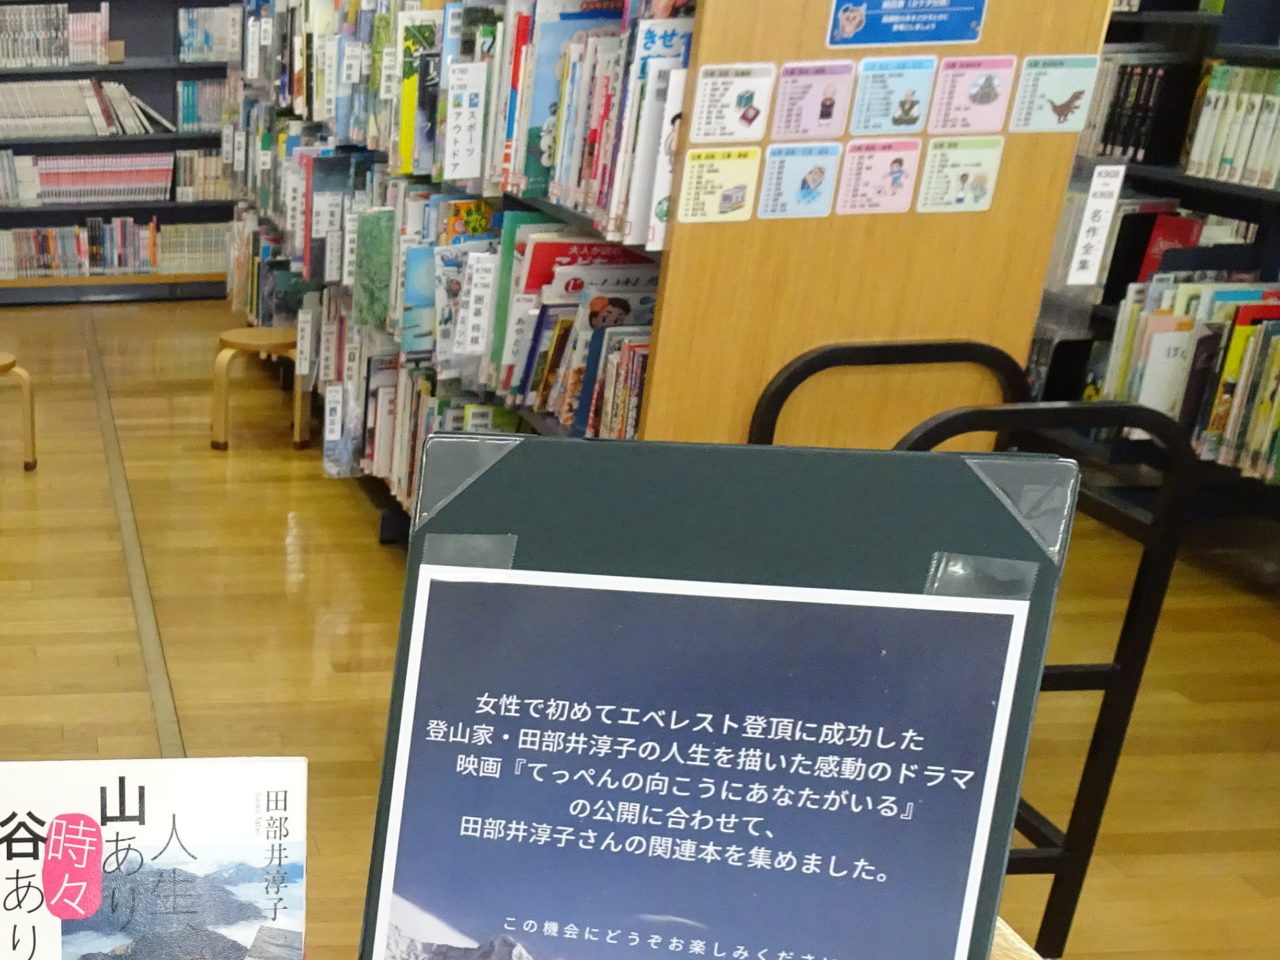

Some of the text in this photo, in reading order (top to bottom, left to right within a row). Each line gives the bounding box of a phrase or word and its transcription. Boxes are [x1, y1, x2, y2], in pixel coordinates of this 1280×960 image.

[451, 111, 463, 173] アウトドア
[465, 111, 477, 158] スポーツ
[425, 719, 976, 790] 登山家・田部井淳子の人生を描いた感動のドラマ
[475, 692, 925, 751] 女性で初めてエベレスト登頂に成功した
[456, 754, 914, 820] 映画『てっぺんの向こうにあなたがいる』
[569, 799, 774, 838] の公開に合わせて、
[47, 819, 98, 915] 時々
[261, 790, 290, 922] 田部井淳子
[460, 816, 888, 883] 田部井淳子さんの関連本を集めました。
